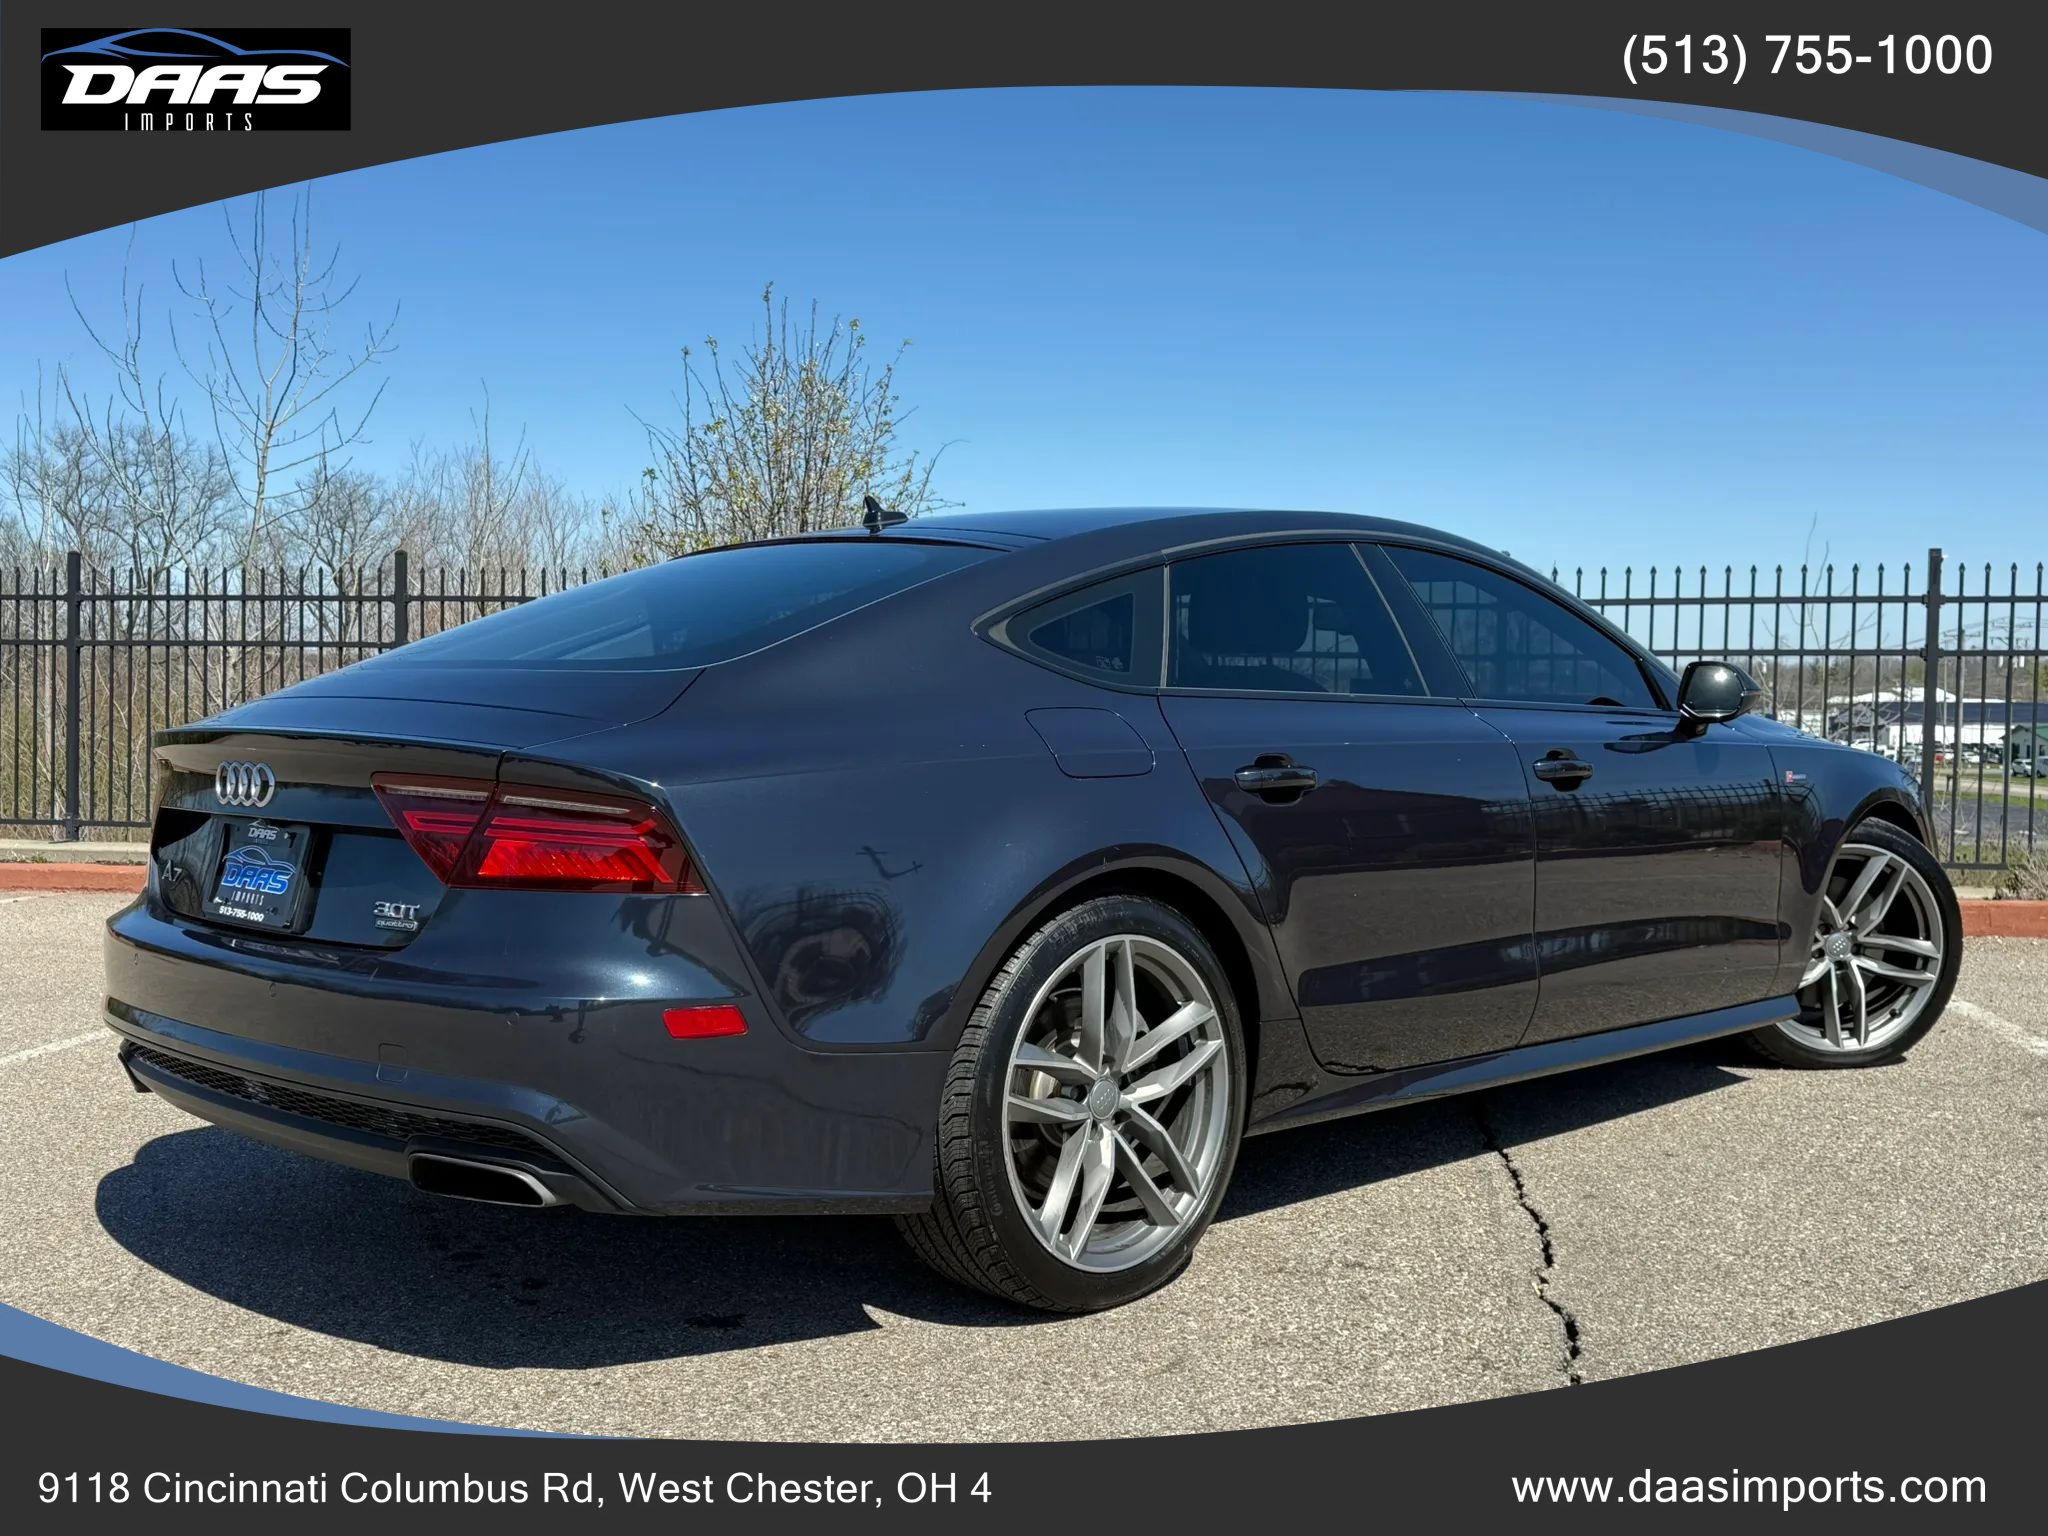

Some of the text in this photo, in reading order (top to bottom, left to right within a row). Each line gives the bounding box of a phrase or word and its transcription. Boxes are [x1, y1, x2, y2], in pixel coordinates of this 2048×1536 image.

[248, 827, 278, 840] DAAS
[161, 860, 183, 881] A7
[222, 863, 293, 894] DAAS
[231, 891, 264, 906] IMPORTS
[218, 905, 264, 922] 513-755-1000
[377, 920, 414, 929] quattro
